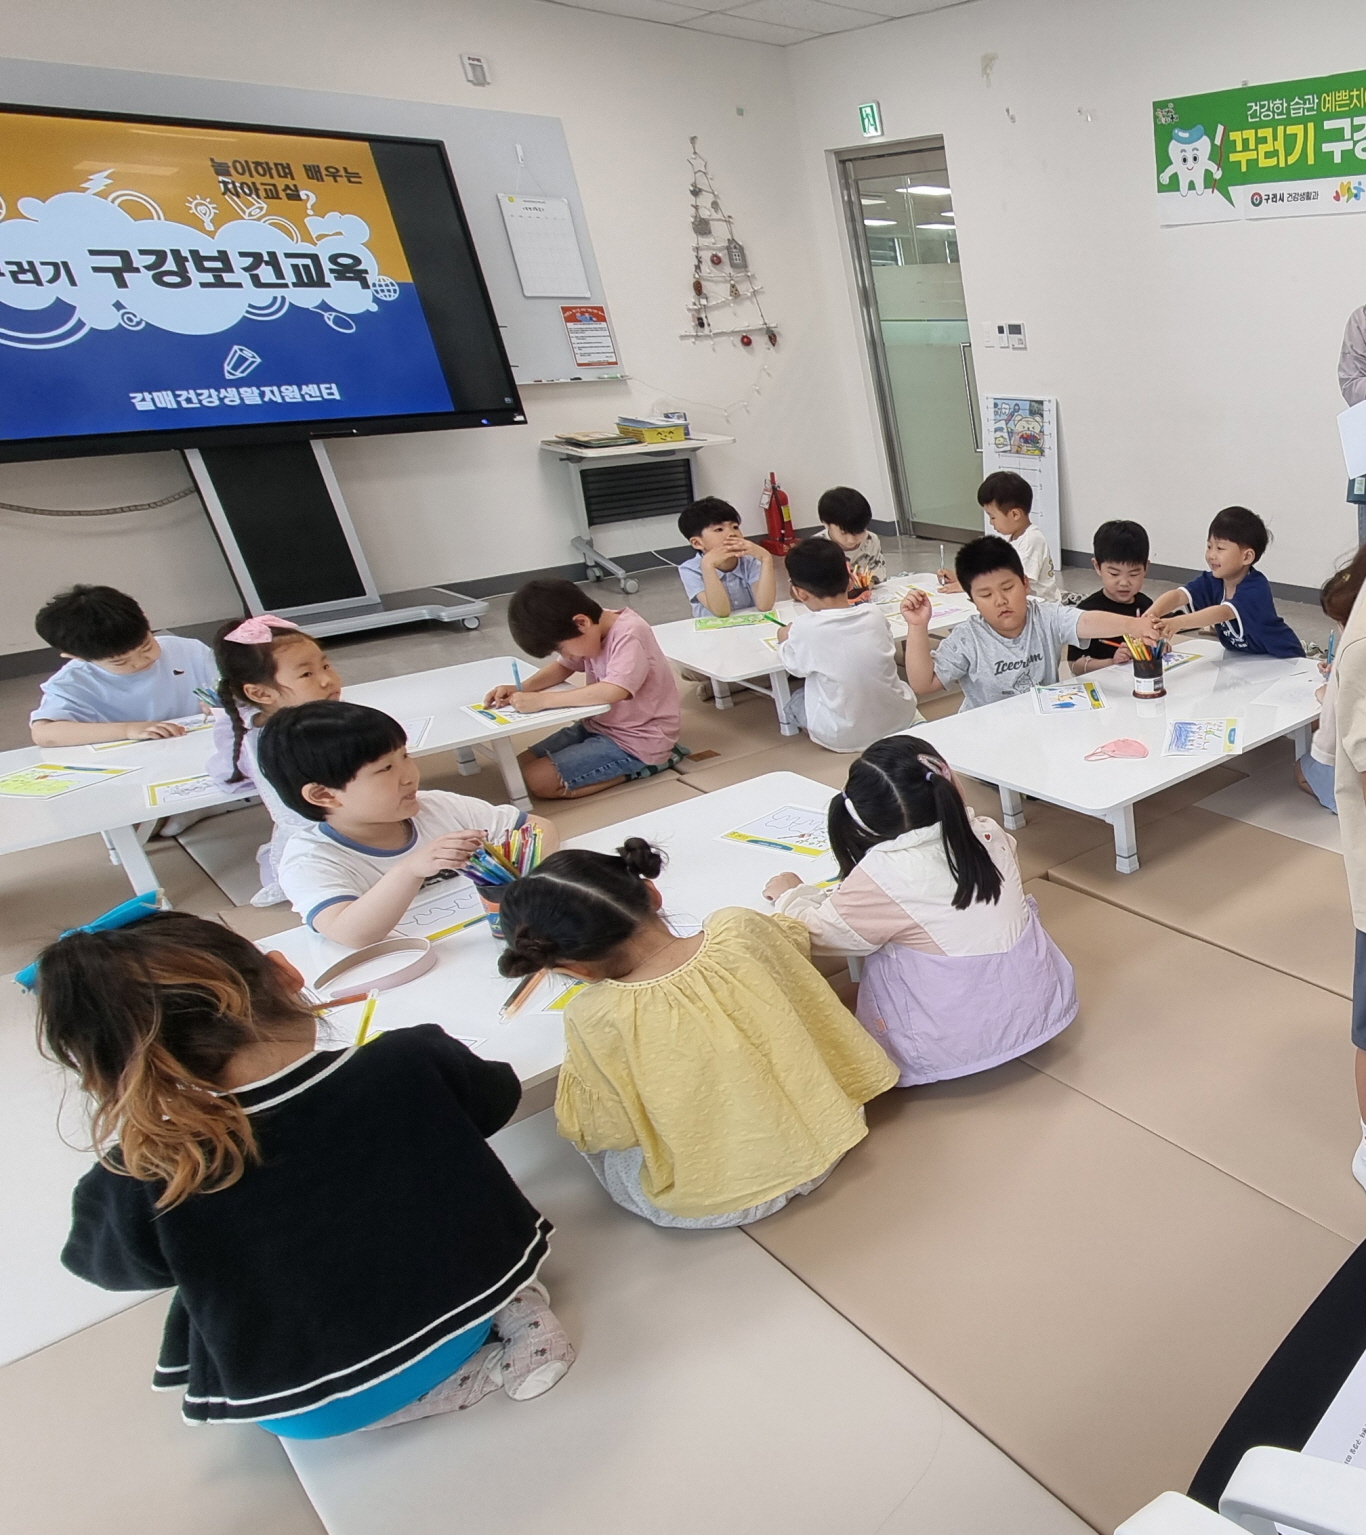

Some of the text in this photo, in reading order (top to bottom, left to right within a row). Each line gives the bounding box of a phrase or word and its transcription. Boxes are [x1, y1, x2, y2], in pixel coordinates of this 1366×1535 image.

[1246, 98, 1288, 122] 건강한
[1289, 94, 1319, 118] 습관
[1229, 122, 1315, 172] 꾸러기
[208, 157, 363, 186] 놀이하며 배우는
[1263, 191, 1319, 204] 구리시 건강생활과
[0, 248, 371, 290] 러기 구강보건교육
[129, 383, 341, 411] 갈매건강생활지원센터
